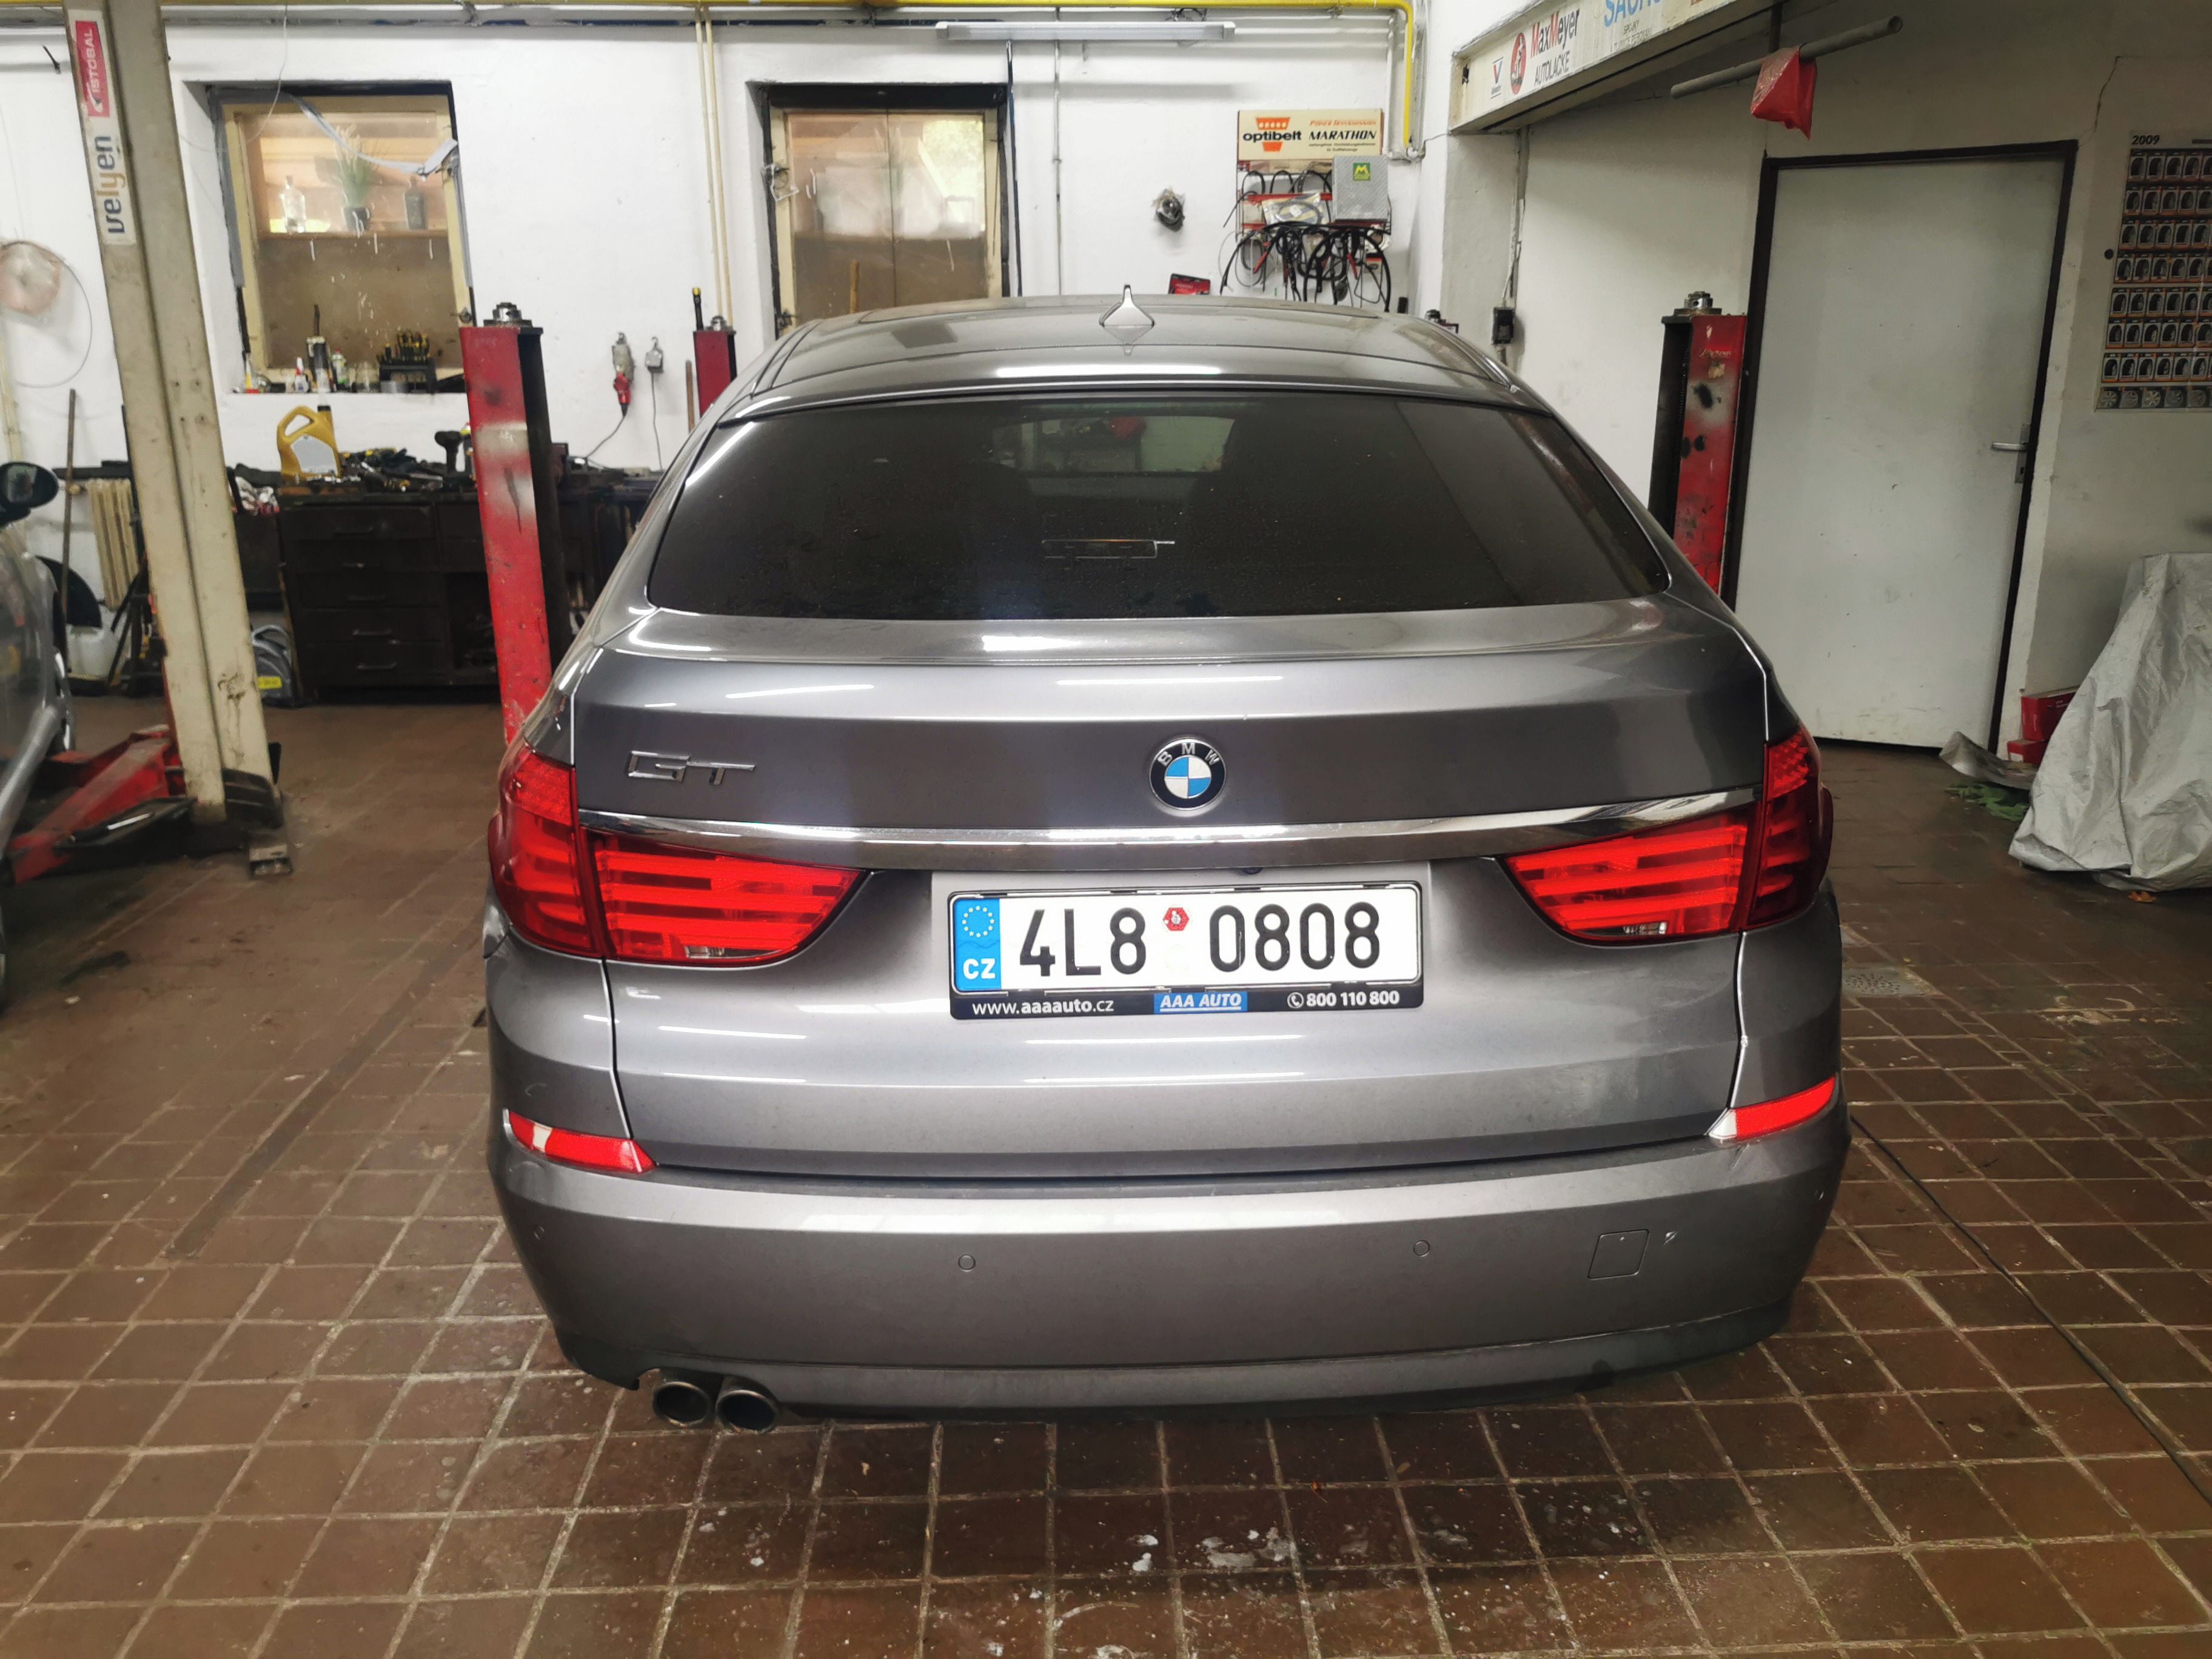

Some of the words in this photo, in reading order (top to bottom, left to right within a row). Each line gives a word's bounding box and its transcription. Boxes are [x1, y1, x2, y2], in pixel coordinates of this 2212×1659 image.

[1604, 0, 1660, 27] SAC
[1530, 7, 1580, 58] MaxMeyer
[84, 28, 101, 92] ISTOBAL
[1534, 50, 1570, 86] AUTOLACKE
[1242, 130, 1302, 143] optibelt
[1309, 130, 1377, 141] MARATHON
[2131, 135, 2160, 146] 2009
[94, 135, 127, 234] velyen
[1158, 742, 1220, 766] BMW
[625, 749, 756, 786] GT
[1020, 907, 1147, 977] 4L8
[1209, 902, 1380, 973] 0808
[963, 957, 996, 980] CZ
[972, 999, 1114, 1016] www.aaaauto.cz
[1159, 994, 1195, 1008] AAA
[1198, 993, 1242, 1007] AUTO
[1306, 992, 1336, 1007] 800
[1341, 991, 1367, 1006] 110
[1369, 990, 1400, 1005] 800
